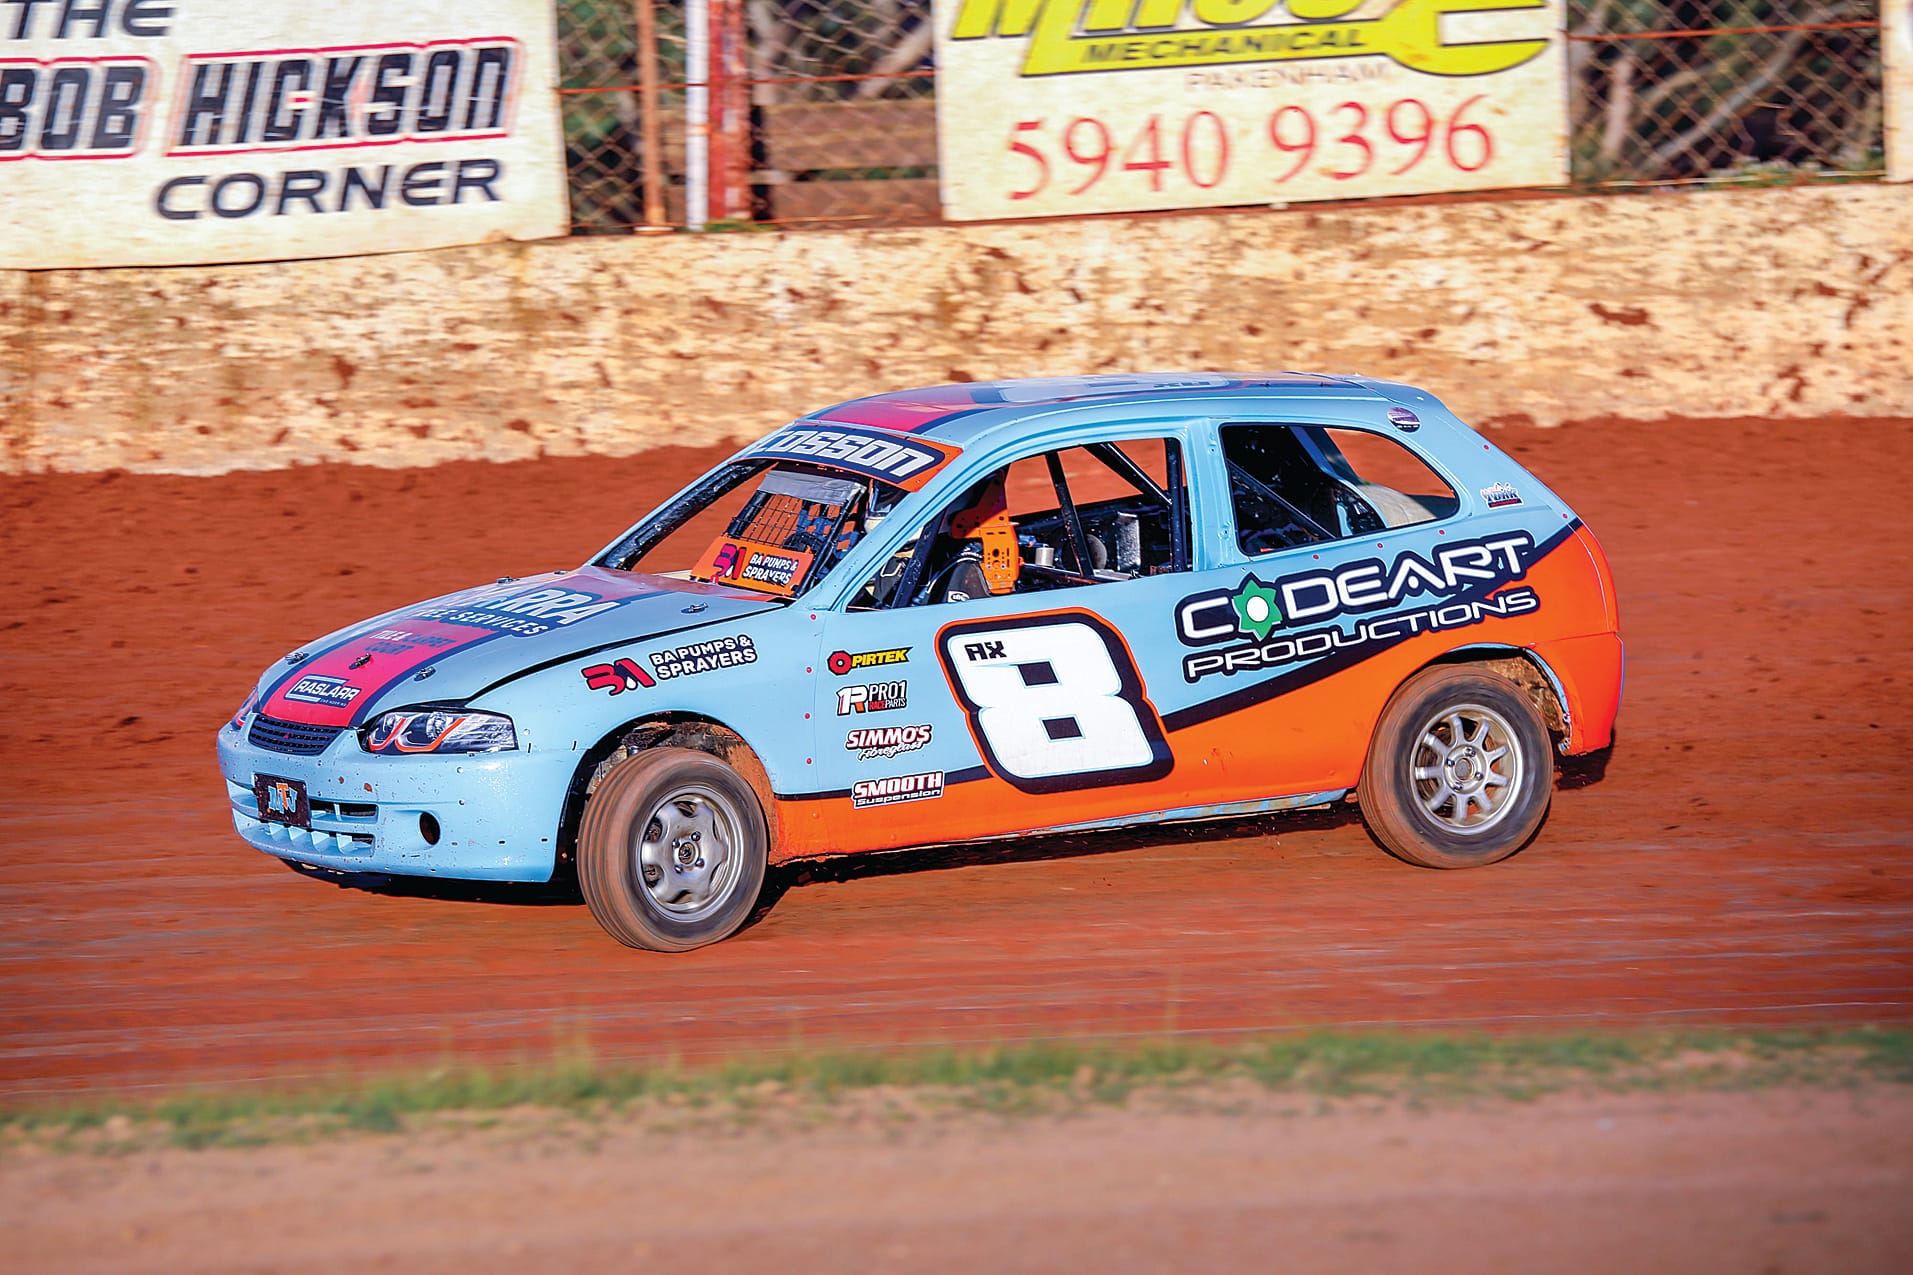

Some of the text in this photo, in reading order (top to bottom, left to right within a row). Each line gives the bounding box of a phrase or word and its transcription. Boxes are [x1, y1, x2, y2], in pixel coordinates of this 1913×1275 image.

[8, 0, 176, 38] THE
[1083, 29, 1365, 62] MECHANICAL
[1184, 60, 1391, 91] PAKENHAM
[0, 46, 512, 150] BOB HICKSON
[1009, 94, 1494, 200] 5940 9396
[156, 158, 503, 219] CORNER
[742, 566, 792, 584] SPRAYERS
[750, 553, 799, 571] BA PUMPS &
[450, 610, 549, 635] SERVICES
[1187, 591, 1537, 678] PRODUCTIONS
[651, 635, 753, 666] BA PUMPS &
[657, 648, 757, 679] SPRAYERS
[852, 649, 907, 667] PIRTEK
[869, 681, 906, 701] PRO1
[947, 622, 1154, 779] 8
[846, 725, 930, 748] SIMMO'S
[854, 772, 942, 799] SMOOTH
[857, 789, 941, 806] Suspension
